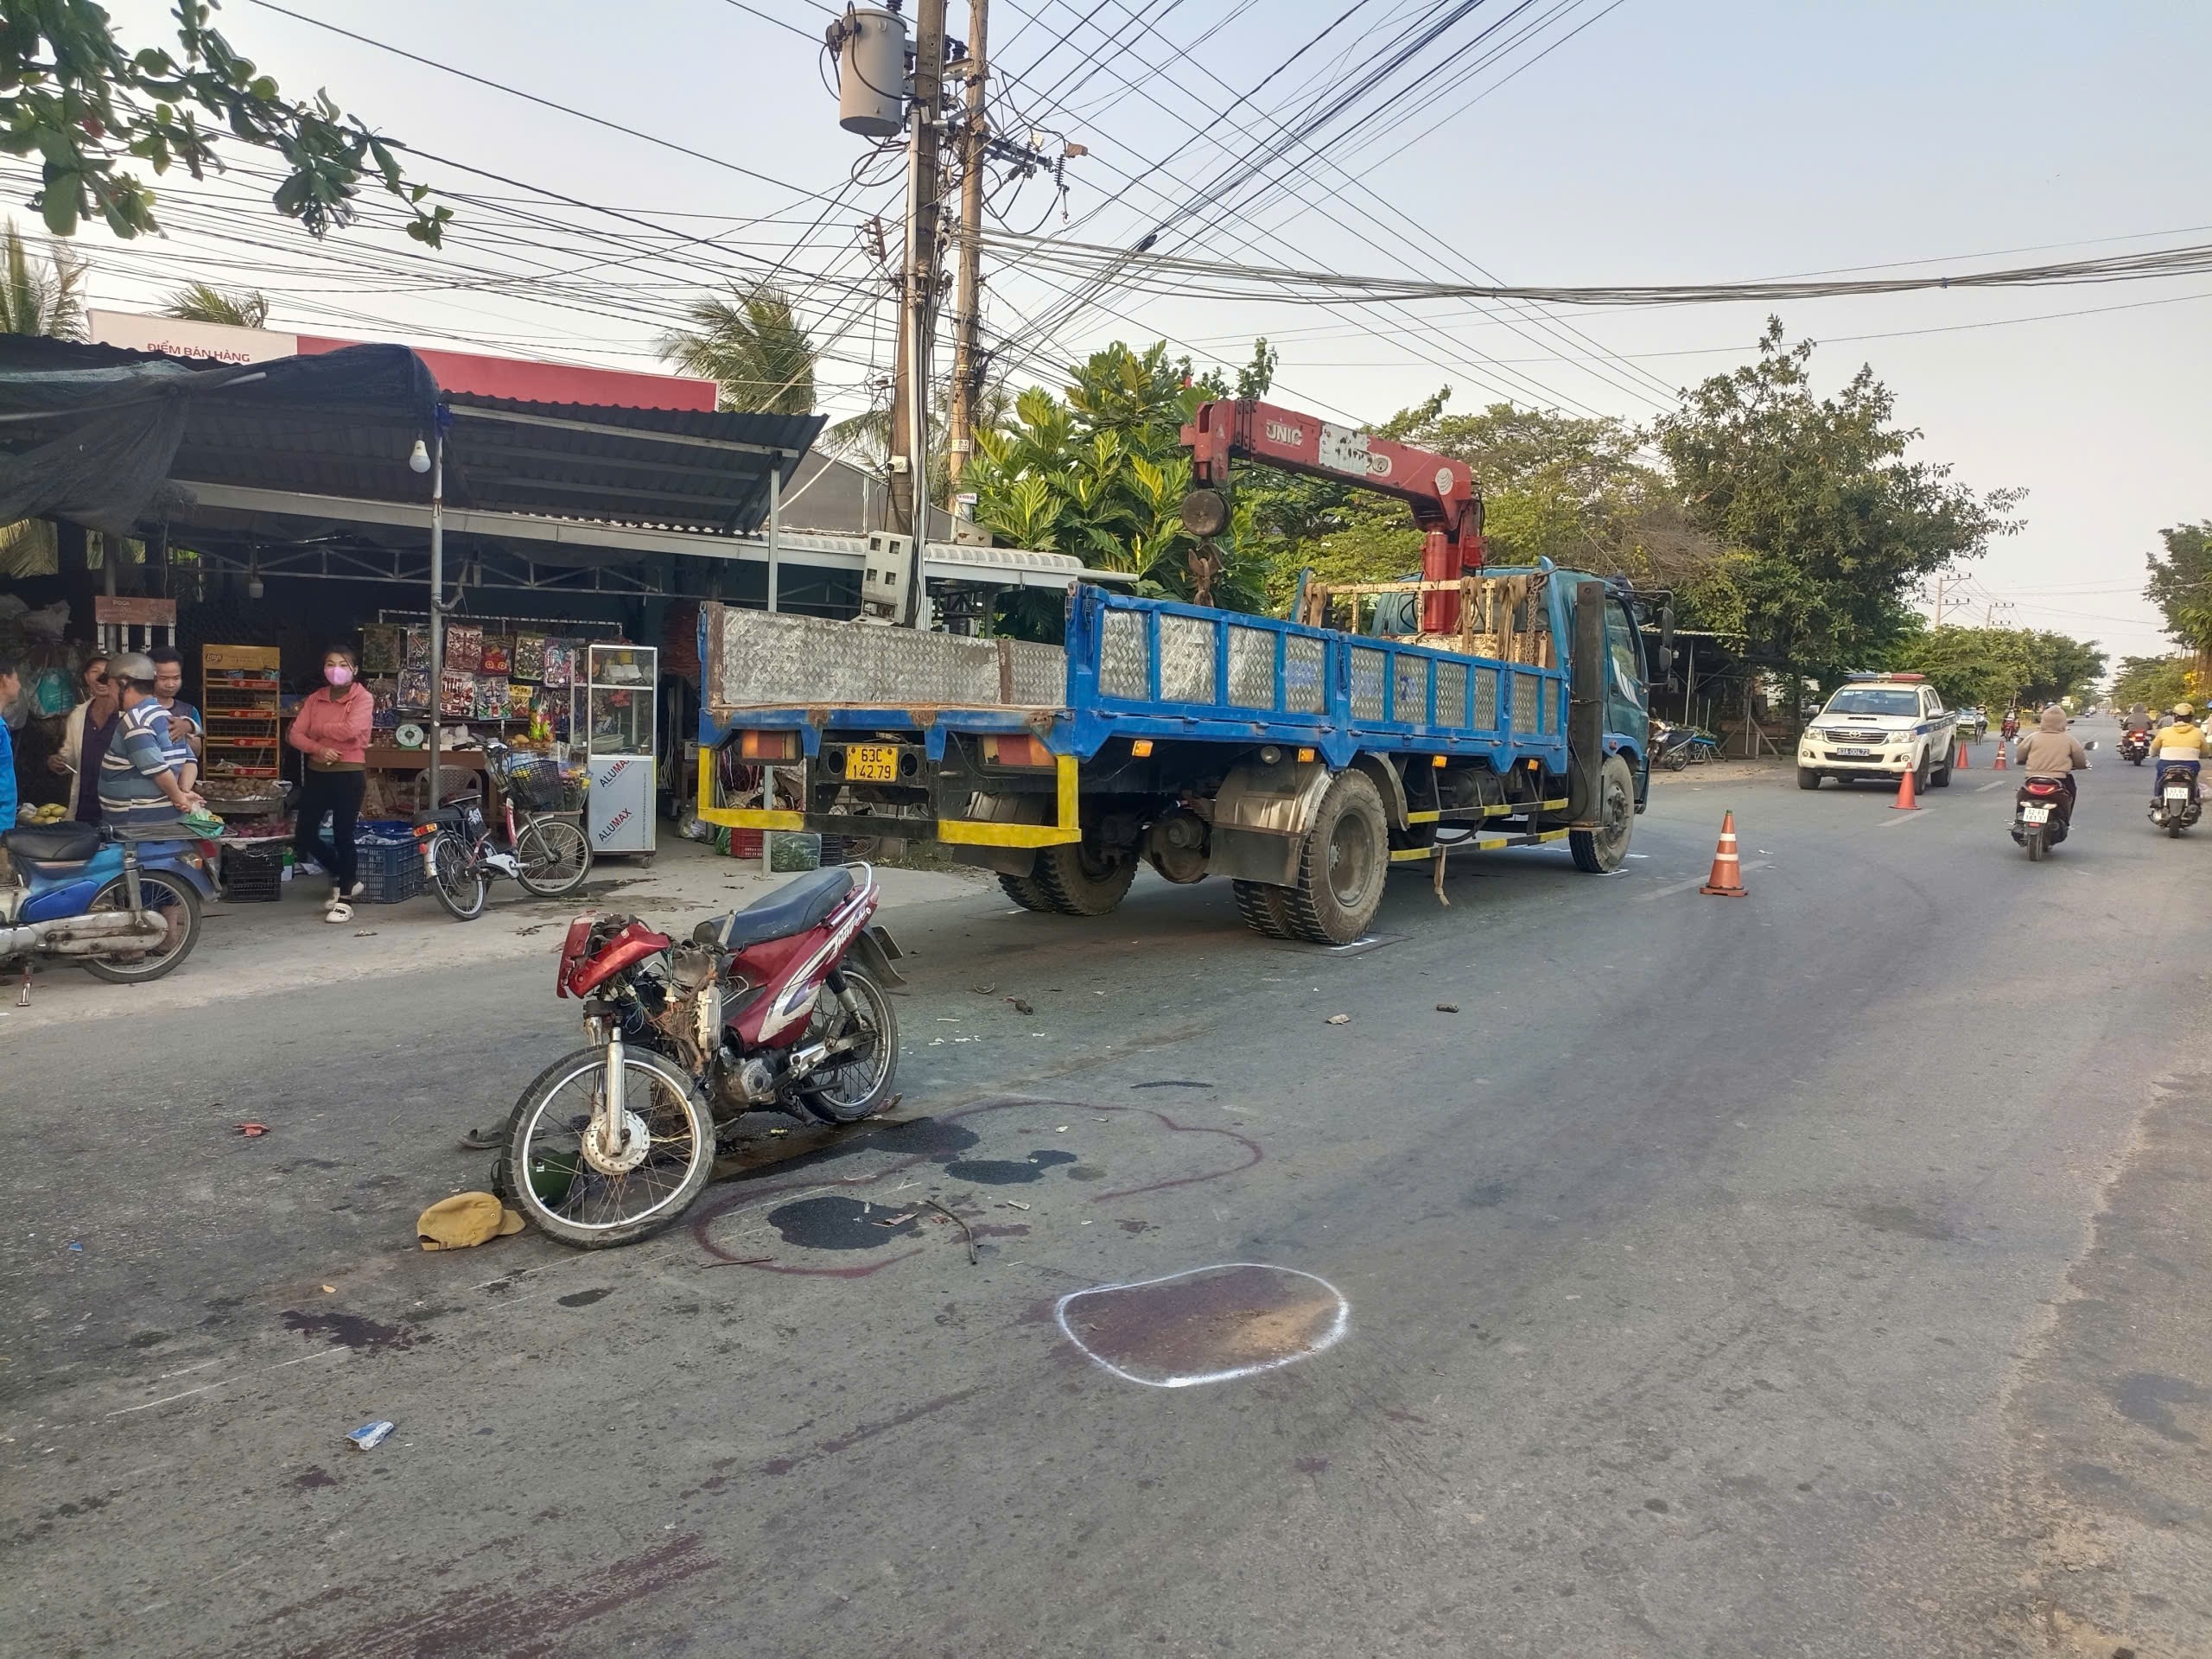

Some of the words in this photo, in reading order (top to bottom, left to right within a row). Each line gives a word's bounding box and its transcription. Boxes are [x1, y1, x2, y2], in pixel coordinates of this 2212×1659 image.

[147, 340, 181, 354] ĐIỂM
[183, 346, 211, 357] BÁN
[213, 349, 251, 362] HÀNG
[1266, 421, 1303, 446] UNIC
[861, 748, 883, 762] 63C
[853, 765, 891, 779] 142.79
[598, 808, 632, 842] ALUMAX
